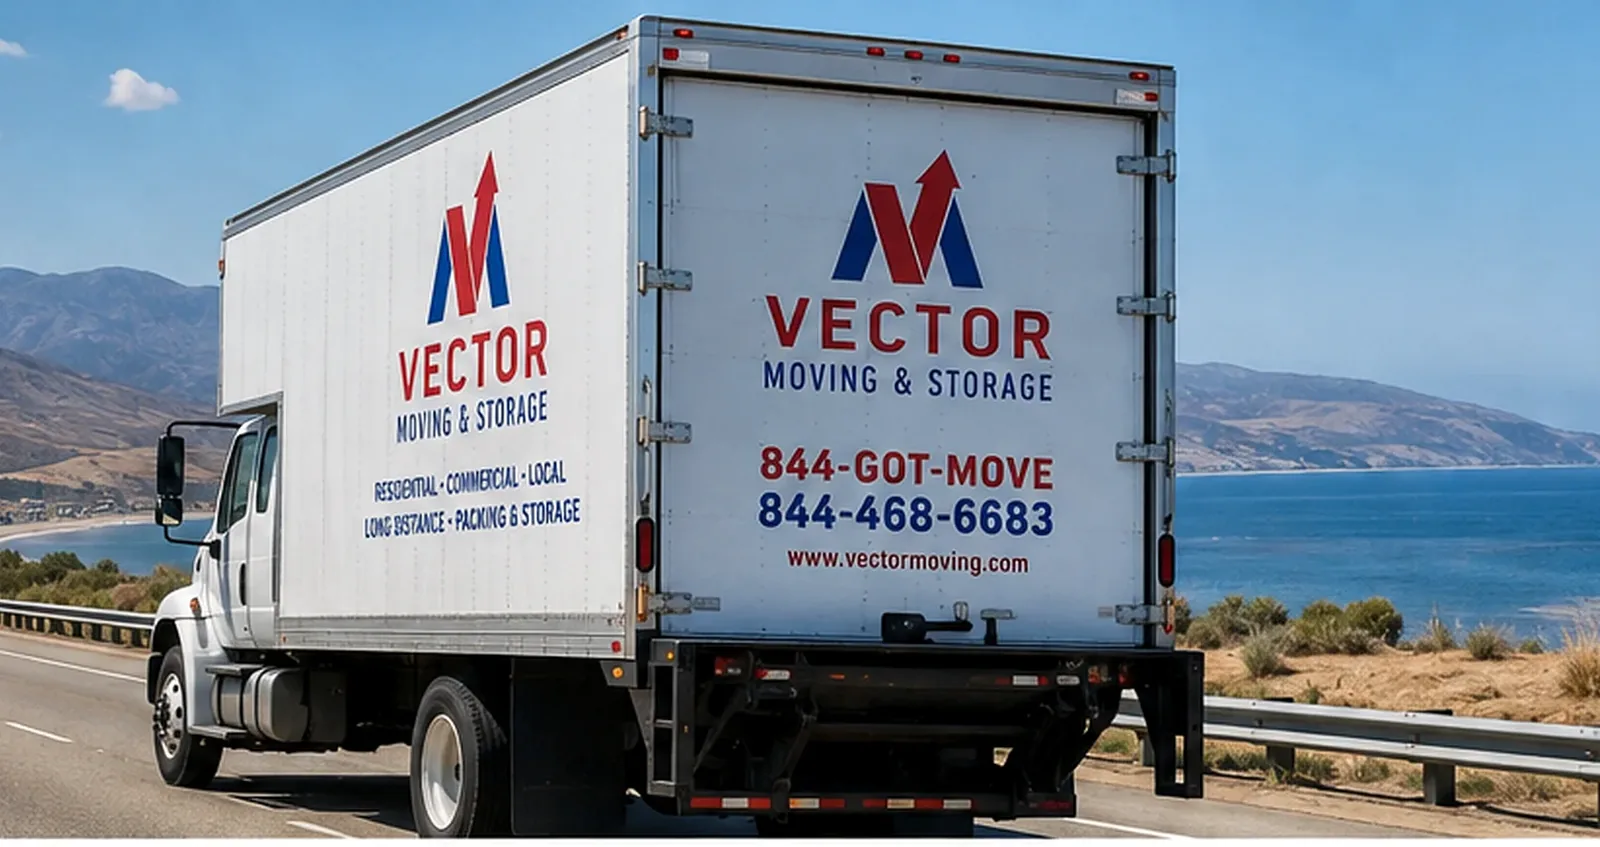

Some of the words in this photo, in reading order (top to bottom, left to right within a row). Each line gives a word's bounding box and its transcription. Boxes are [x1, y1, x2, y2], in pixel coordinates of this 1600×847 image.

[765, 295, 1051, 360] VECTOR
[398, 320, 547, 402] VECTOR
[764, 360, 877, 393] MOVING
[894, 367, 912, 395] &
[928, 369, 1052, 402] STORAGE
[396, 407, 451, 443] MOVING
[459, 404, 470, 433] &
[476, 390, 548, 431] STORAGE
[528, 461, 566, 486] LOCAL
[760, 446, 1053, 490] 844-GOT-MOVE
[455, 505, 506, 531] PACKING
[522, 498, 580, 526] STORAGE
[758, 492, 1053, 536] 844-468-6683
[788, 550, 1028, 576] www.vectormoving.com
